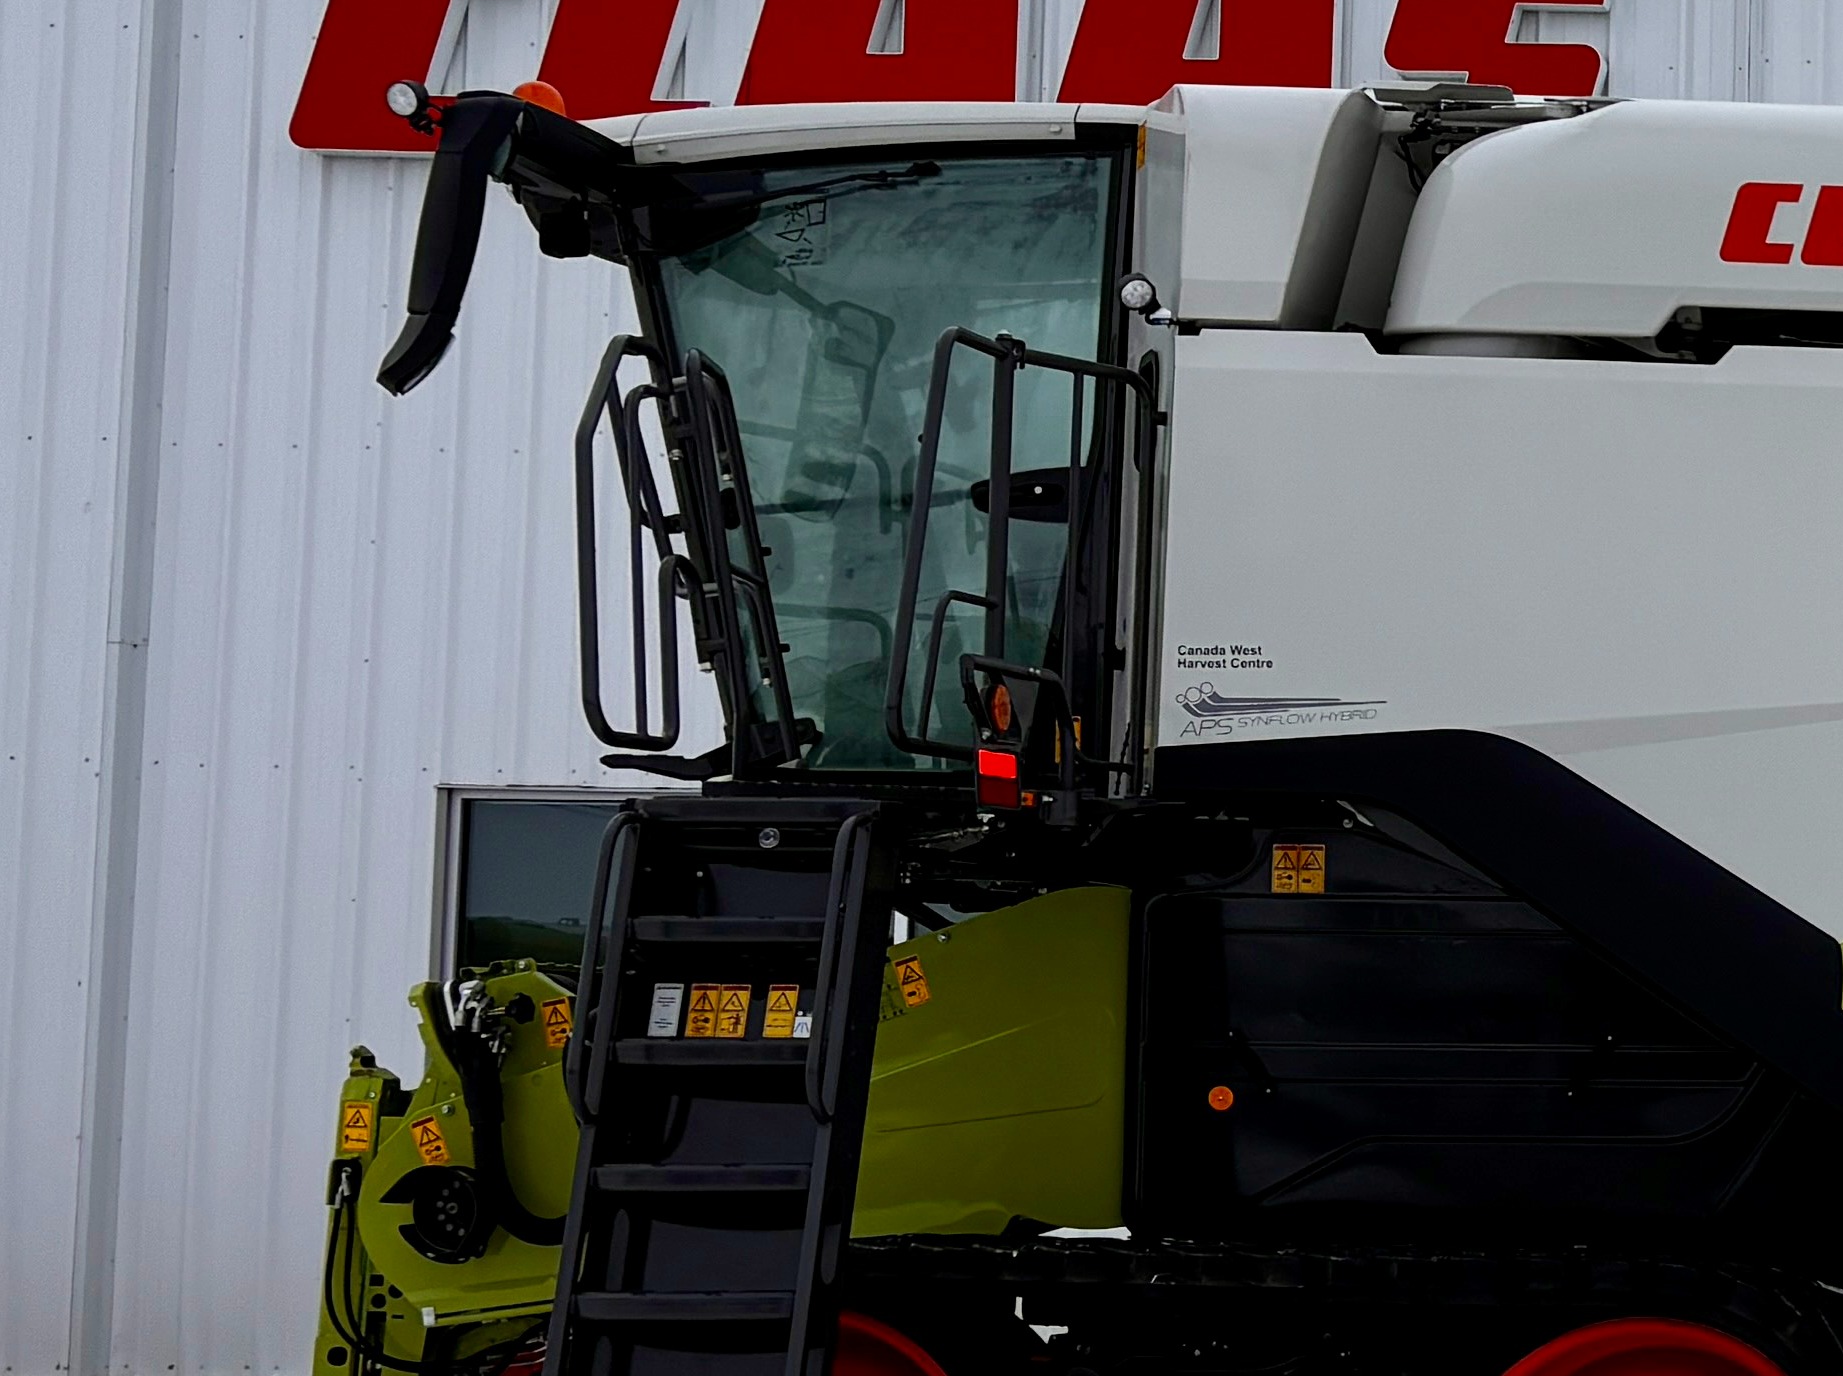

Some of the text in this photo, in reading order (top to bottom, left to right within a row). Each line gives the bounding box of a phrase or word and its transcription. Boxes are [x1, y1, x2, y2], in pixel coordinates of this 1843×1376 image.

[1177, 644, 1262, 656] Canada West
[1177, 657, 1274, 669] Harvest Centre
[1179, 708, 1378, 738] APS SYNFLOW HYBRID
